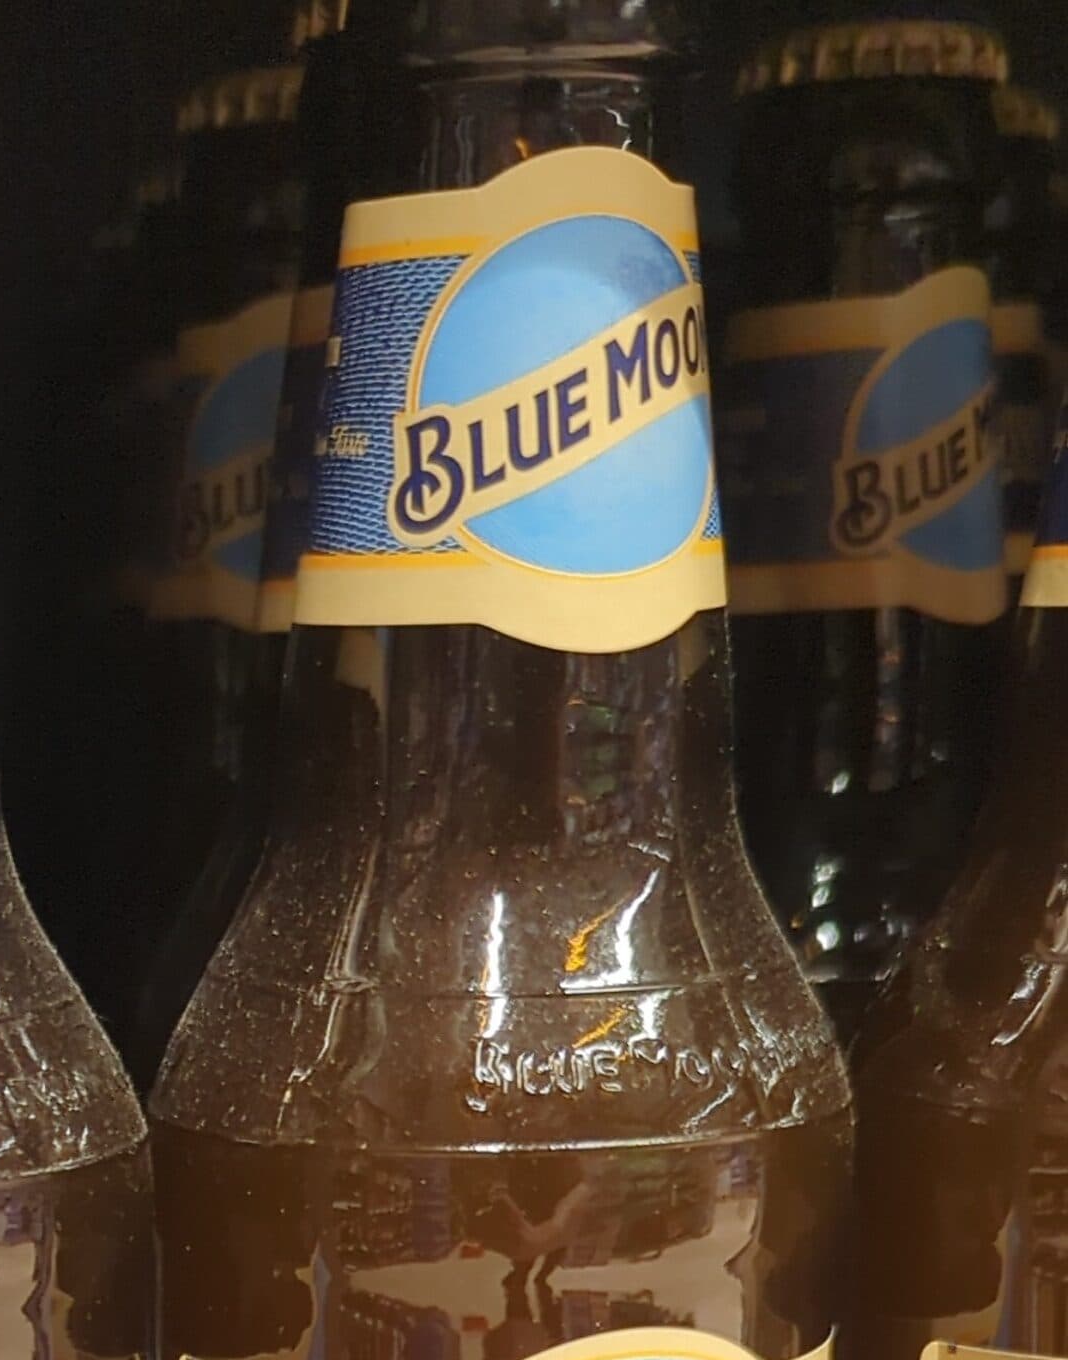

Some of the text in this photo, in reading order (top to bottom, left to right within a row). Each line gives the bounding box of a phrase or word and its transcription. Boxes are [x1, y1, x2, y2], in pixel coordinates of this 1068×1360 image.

[395, 305, 705, 534] BLUE MOO
[836, 427, 969, 547] BLUE
